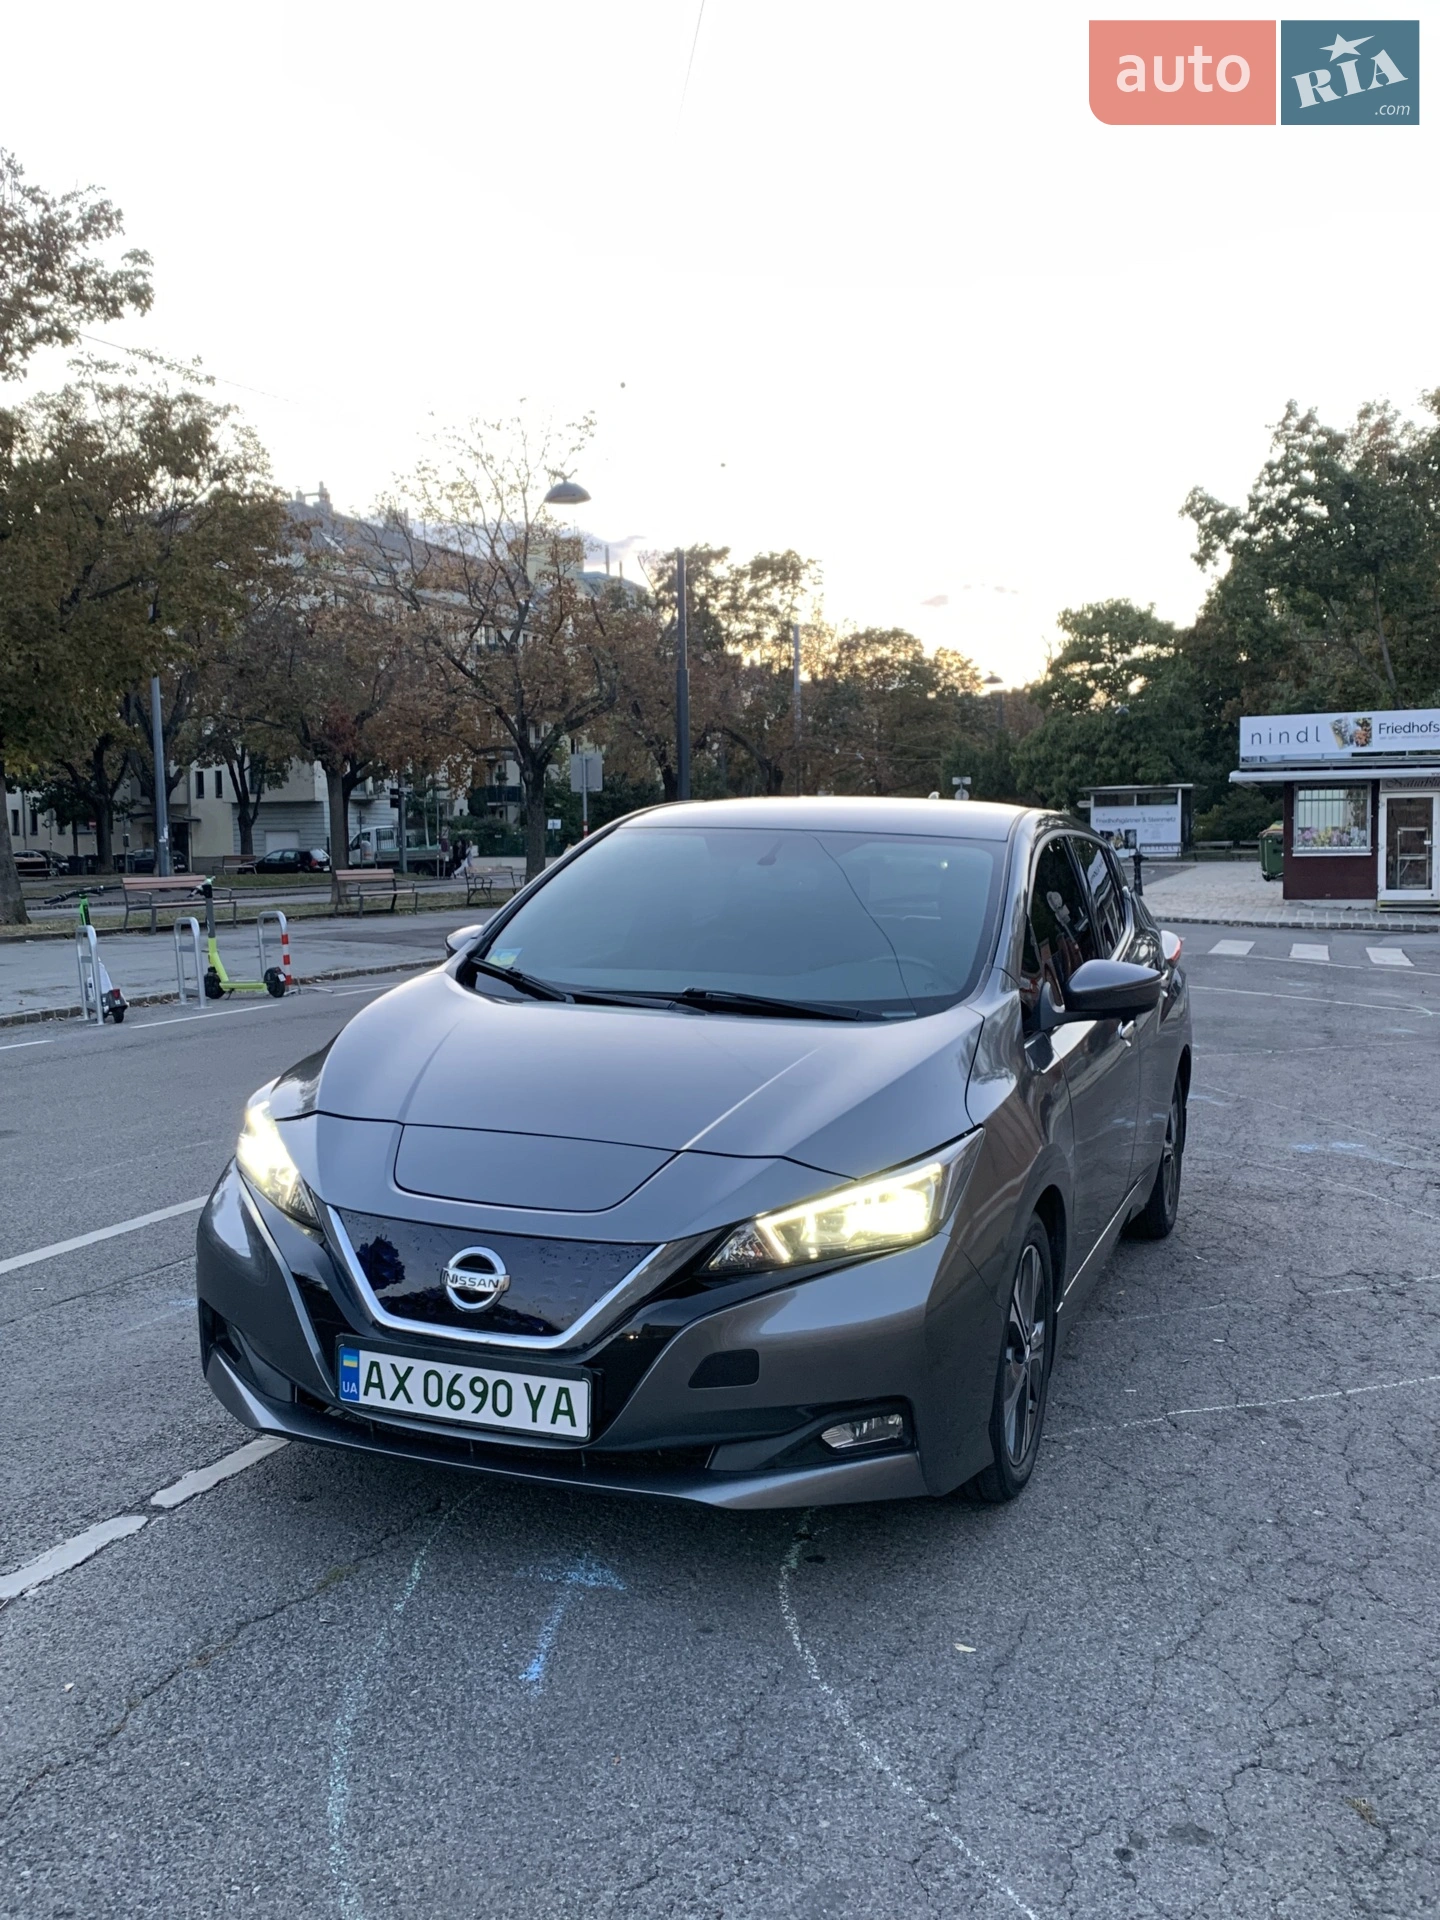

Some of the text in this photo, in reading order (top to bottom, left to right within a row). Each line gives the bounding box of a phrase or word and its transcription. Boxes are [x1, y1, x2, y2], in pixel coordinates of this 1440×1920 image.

[1251, 725, 1321, 745] nindl
[1378, 720, 1440, 735] Friedhofs
[443, 1269, 500, 1289] NISSAN
[342, 1381, 358, 1395] UA
[363, 1360, 577, 1428] AX 0690 YA
